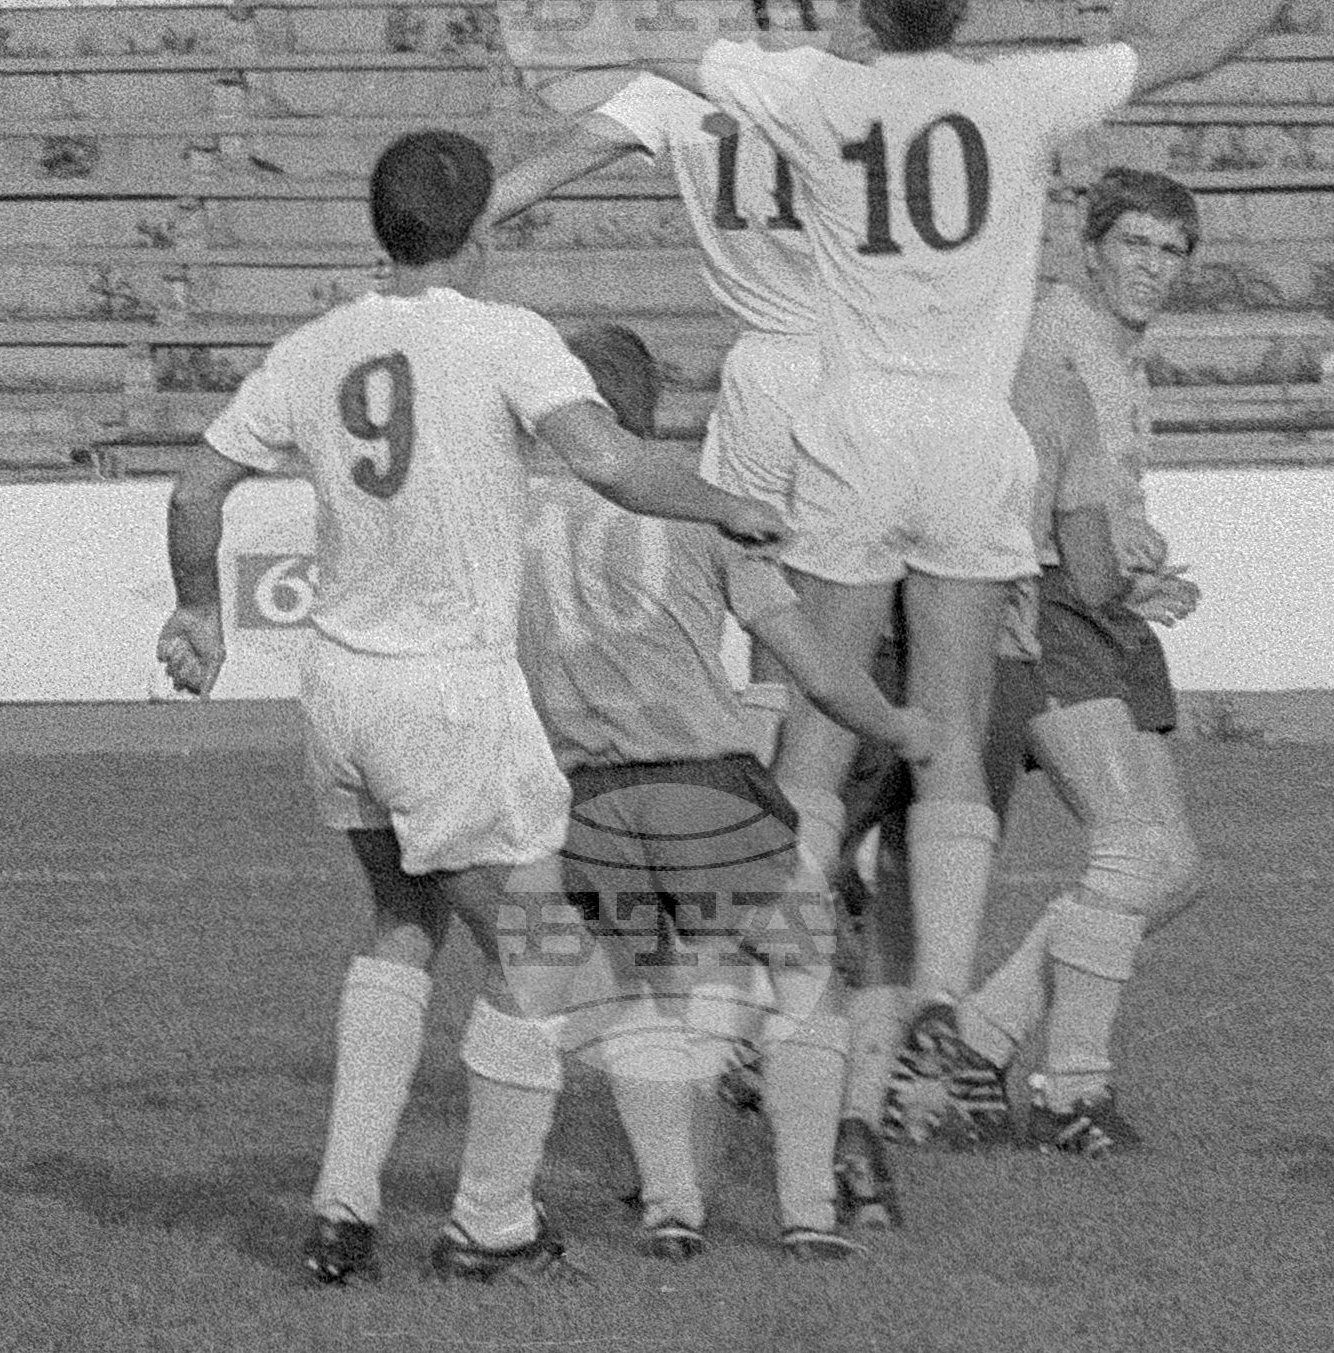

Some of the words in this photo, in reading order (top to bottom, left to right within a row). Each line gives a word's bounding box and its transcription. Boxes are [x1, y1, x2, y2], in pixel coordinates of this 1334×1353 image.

[701, 112, 803, 231] 11
[841, 113, 991, 256] 10
[338, 350, 418, 500] 9
[255, 558, 320, 622] 6
